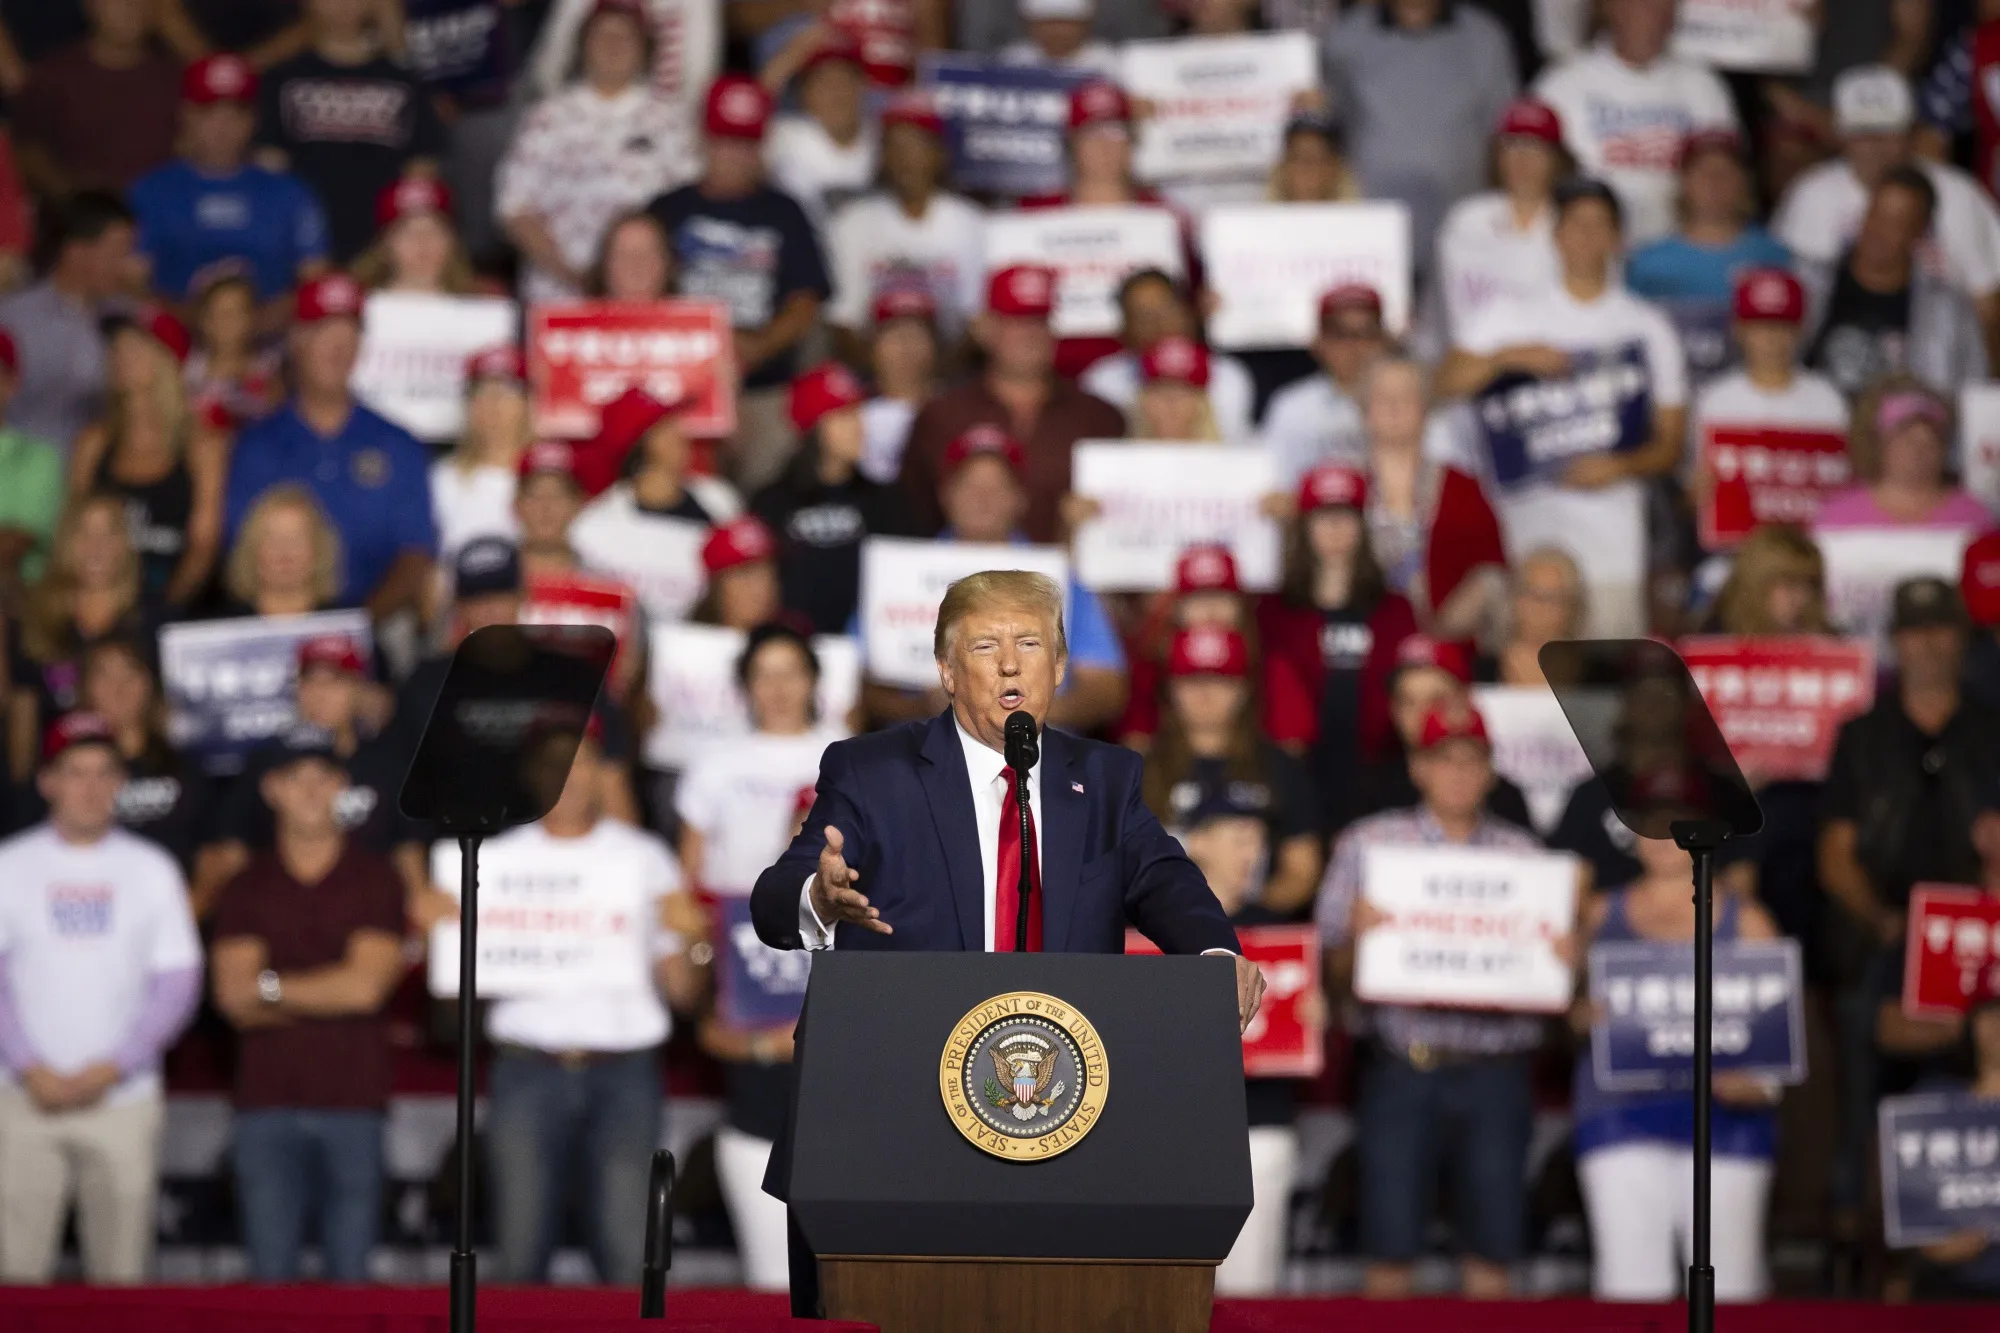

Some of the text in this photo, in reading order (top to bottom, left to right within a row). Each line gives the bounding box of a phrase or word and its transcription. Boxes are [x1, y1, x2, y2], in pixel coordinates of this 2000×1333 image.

[540, 330, 721, 367] TRUMP
[1608, 976, 1788, 1015] TRUMP
[946, 998, 1103, 1153] SEAL OF THE PRESIDENT OF THE UNITED STATES
